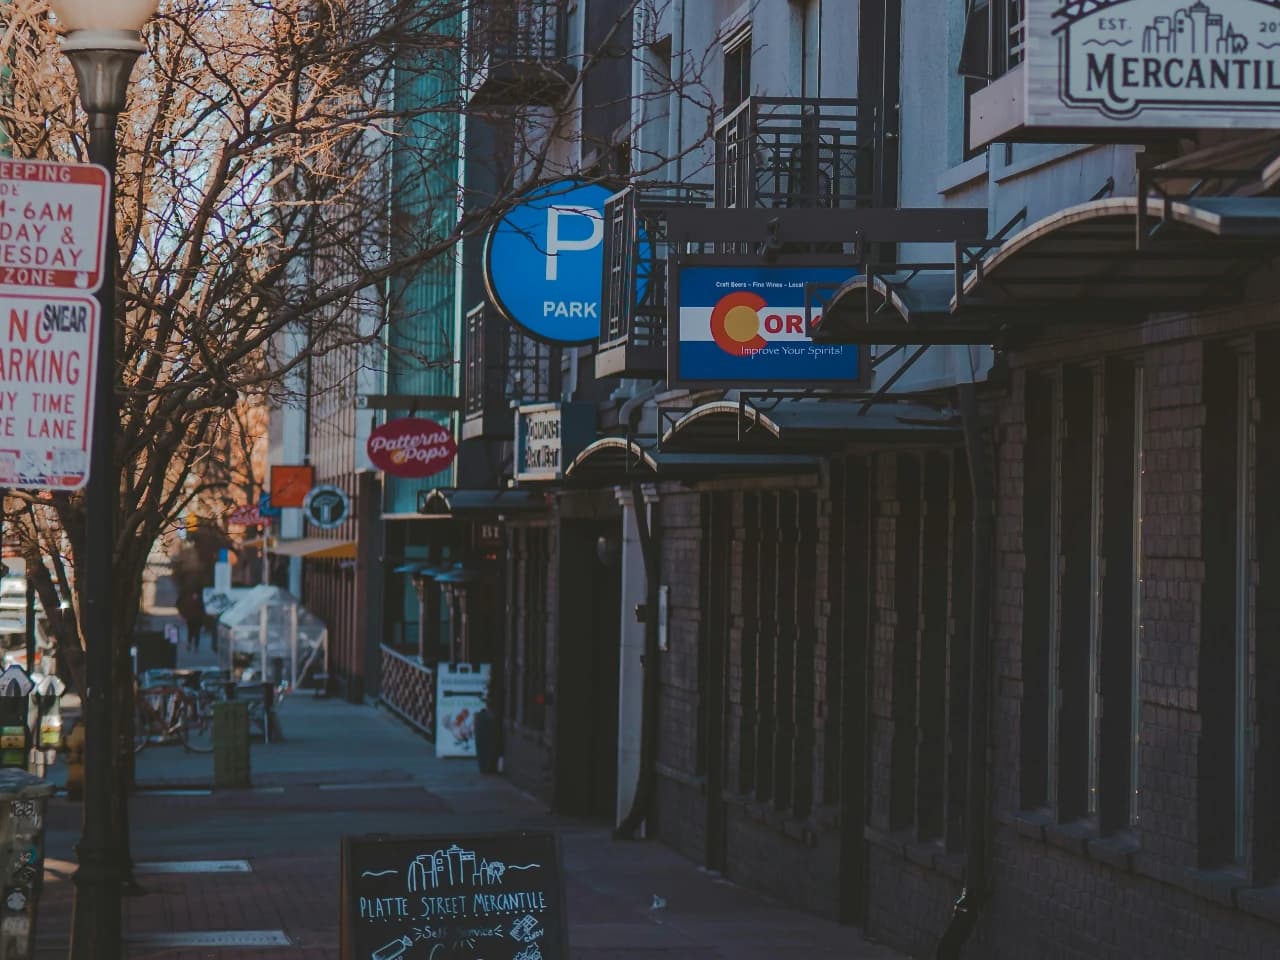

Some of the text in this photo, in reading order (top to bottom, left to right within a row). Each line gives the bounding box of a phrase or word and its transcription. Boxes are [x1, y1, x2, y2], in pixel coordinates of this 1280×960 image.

[1097, 17, 1132, 31] EST.
[61, 226, 75, 245] &
[0, 244, 83, 267] ESDAY
[4, 268, 56, 286] ZONE
[543, 300, 598, 319] PARK
[741, 345, 843, 359] Improve Your Spirits!
[32, 392, 76, 415] TIME
[27, 417, 77, 441] LANE
[370, 430, 449, 453] Patterns
[404, 446, 449, 465] Pops
[359, 890, 548, 918] PLATTE STREET MERCANTILE
